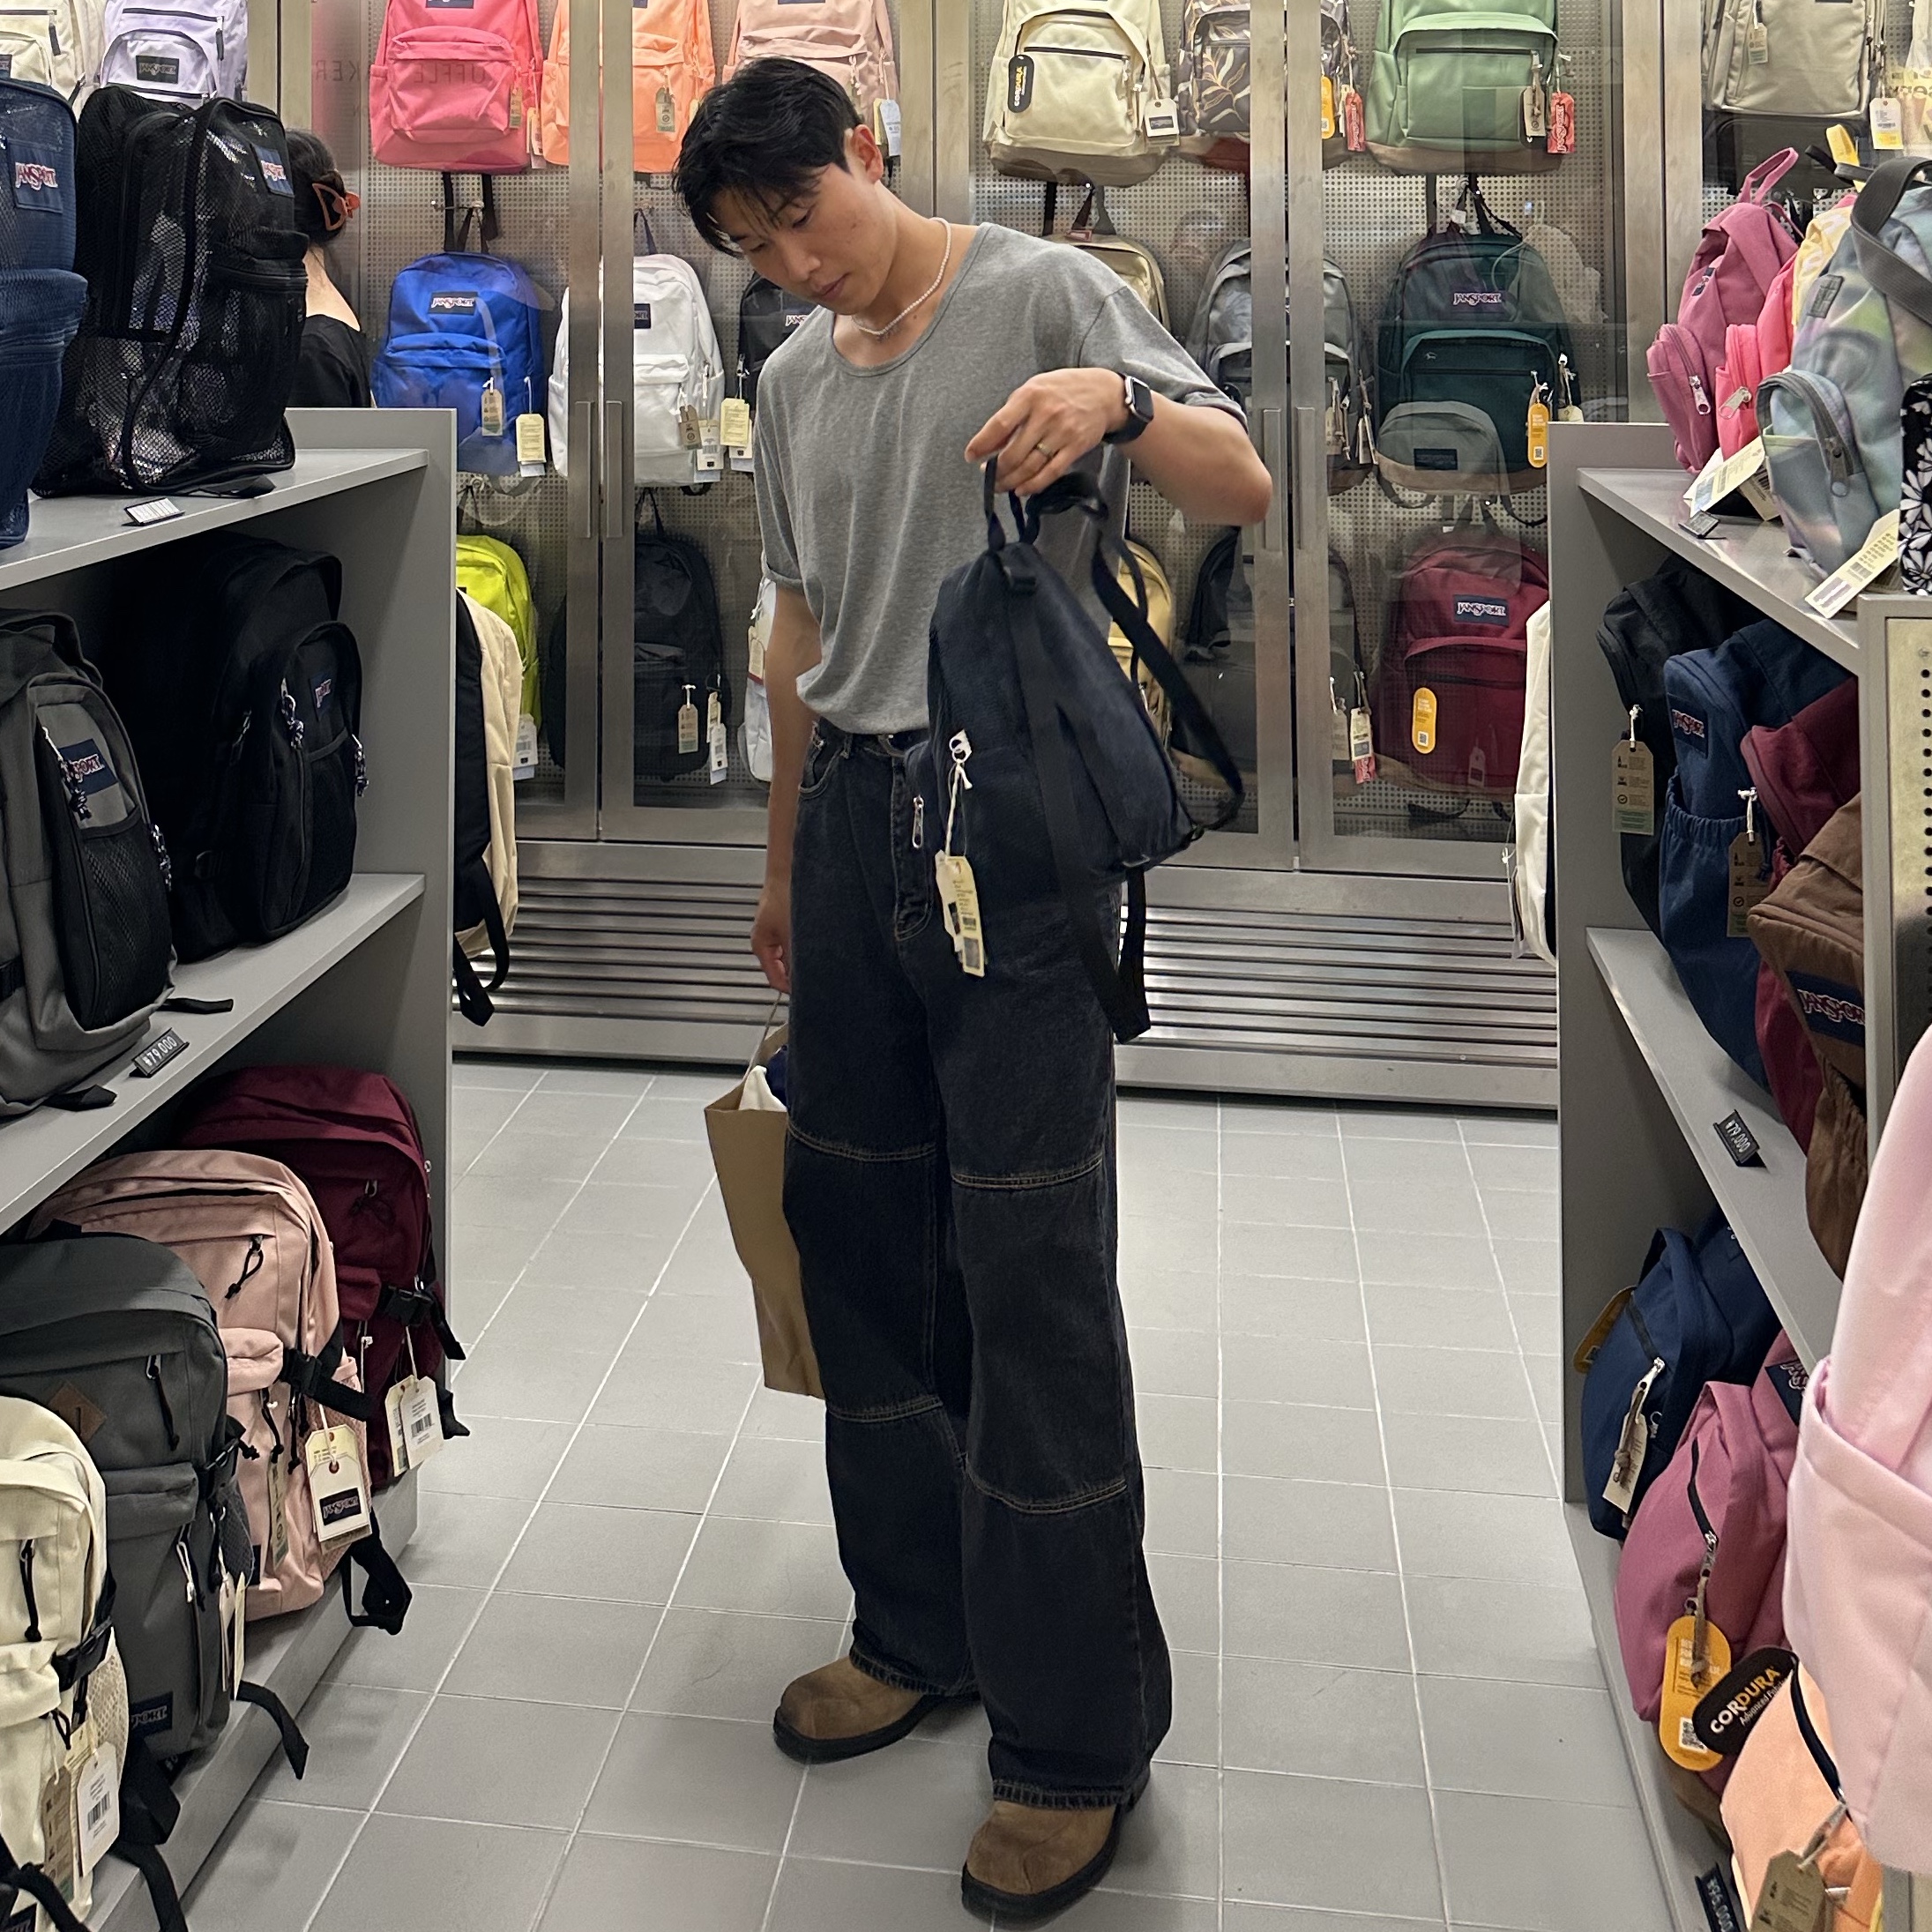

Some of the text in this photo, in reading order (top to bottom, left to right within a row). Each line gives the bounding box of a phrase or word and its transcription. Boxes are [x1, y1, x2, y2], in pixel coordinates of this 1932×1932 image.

[431, 297, 474, 309] JANSPORT
[1453, 292, 1502, 305] JANSPORT
[1457, 601, 1507, 616] JANSPORT
[1797, 988, 1865, 1026] JANSPOR
[1711, 1667, 1780, 1734] CORDURA
